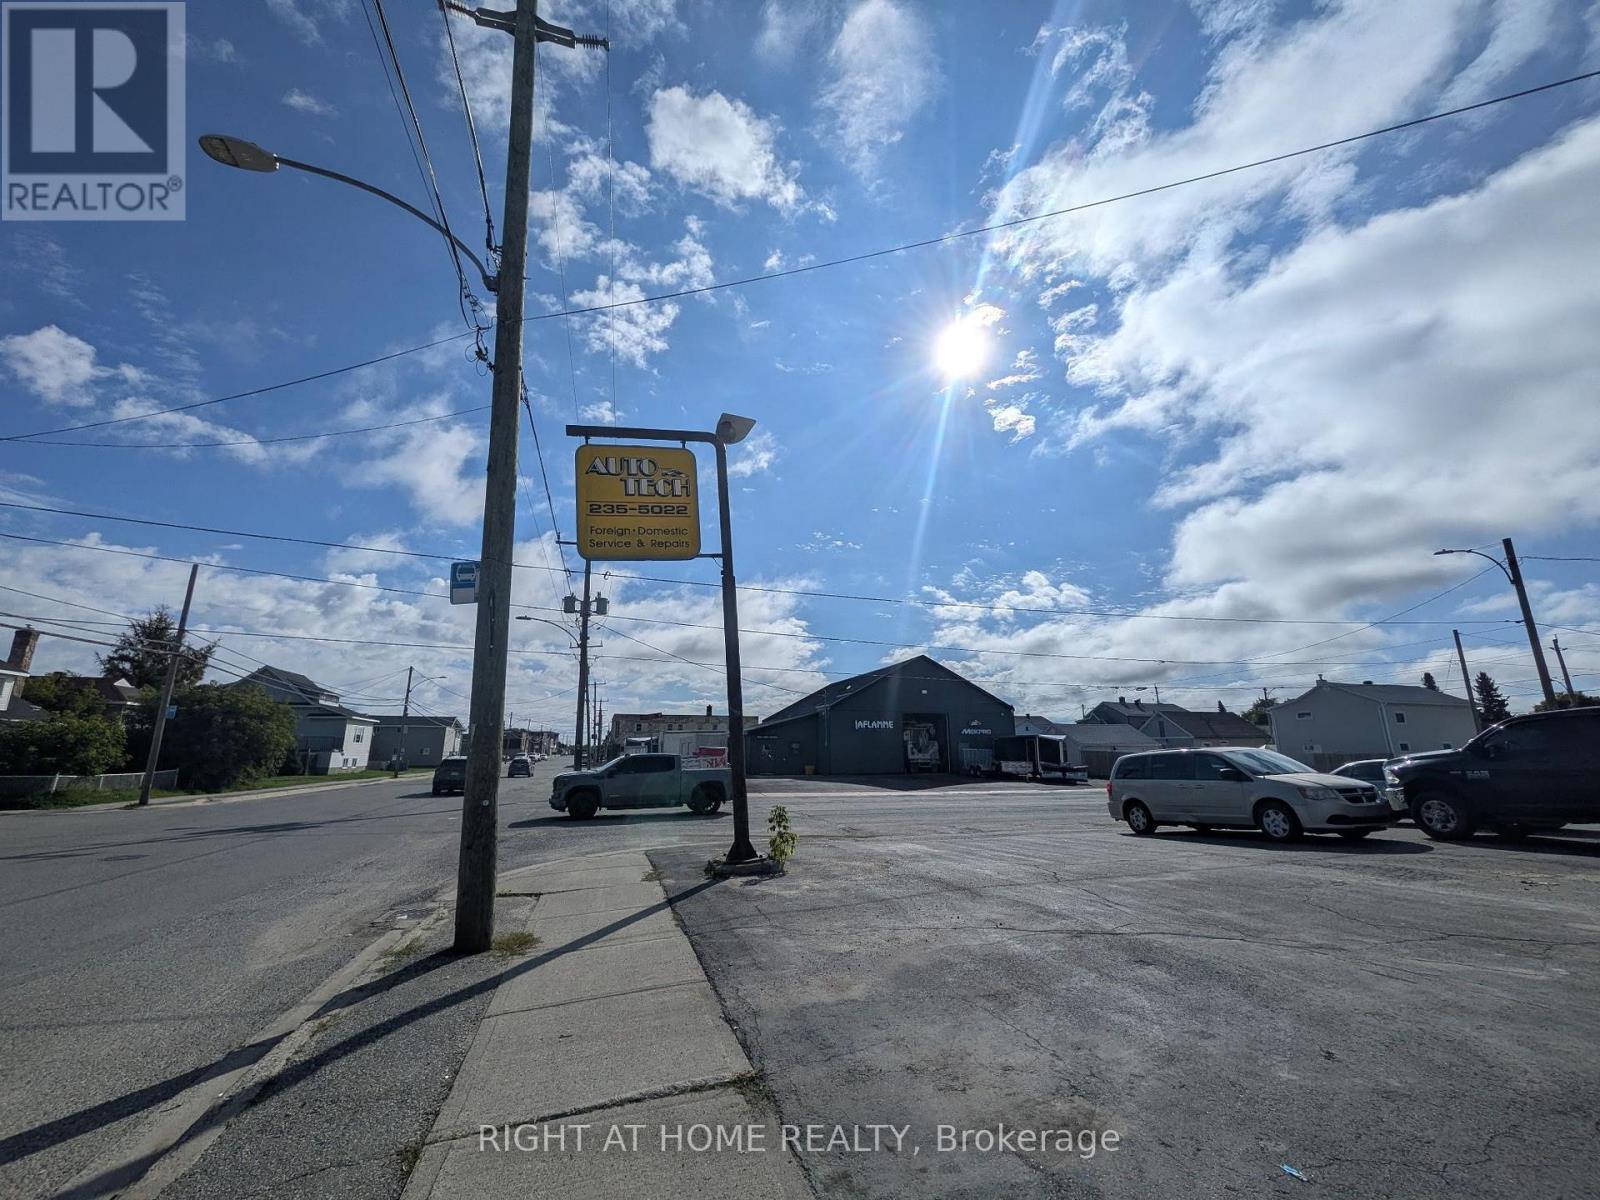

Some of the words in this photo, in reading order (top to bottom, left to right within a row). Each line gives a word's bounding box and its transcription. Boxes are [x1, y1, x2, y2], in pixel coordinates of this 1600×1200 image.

[585, 456, 657, 477] AUTO
[620, 478, 691, 497] TECH
[589, 503, 689, 515] 235-5022
[590, 526, 631, 537] Foreign
[638, 526, 689, 536] Domestic
[589, 539, 631, 548] Service
[637, 539, 646, 548] &
[651, 539, 690, 550] Repairs
